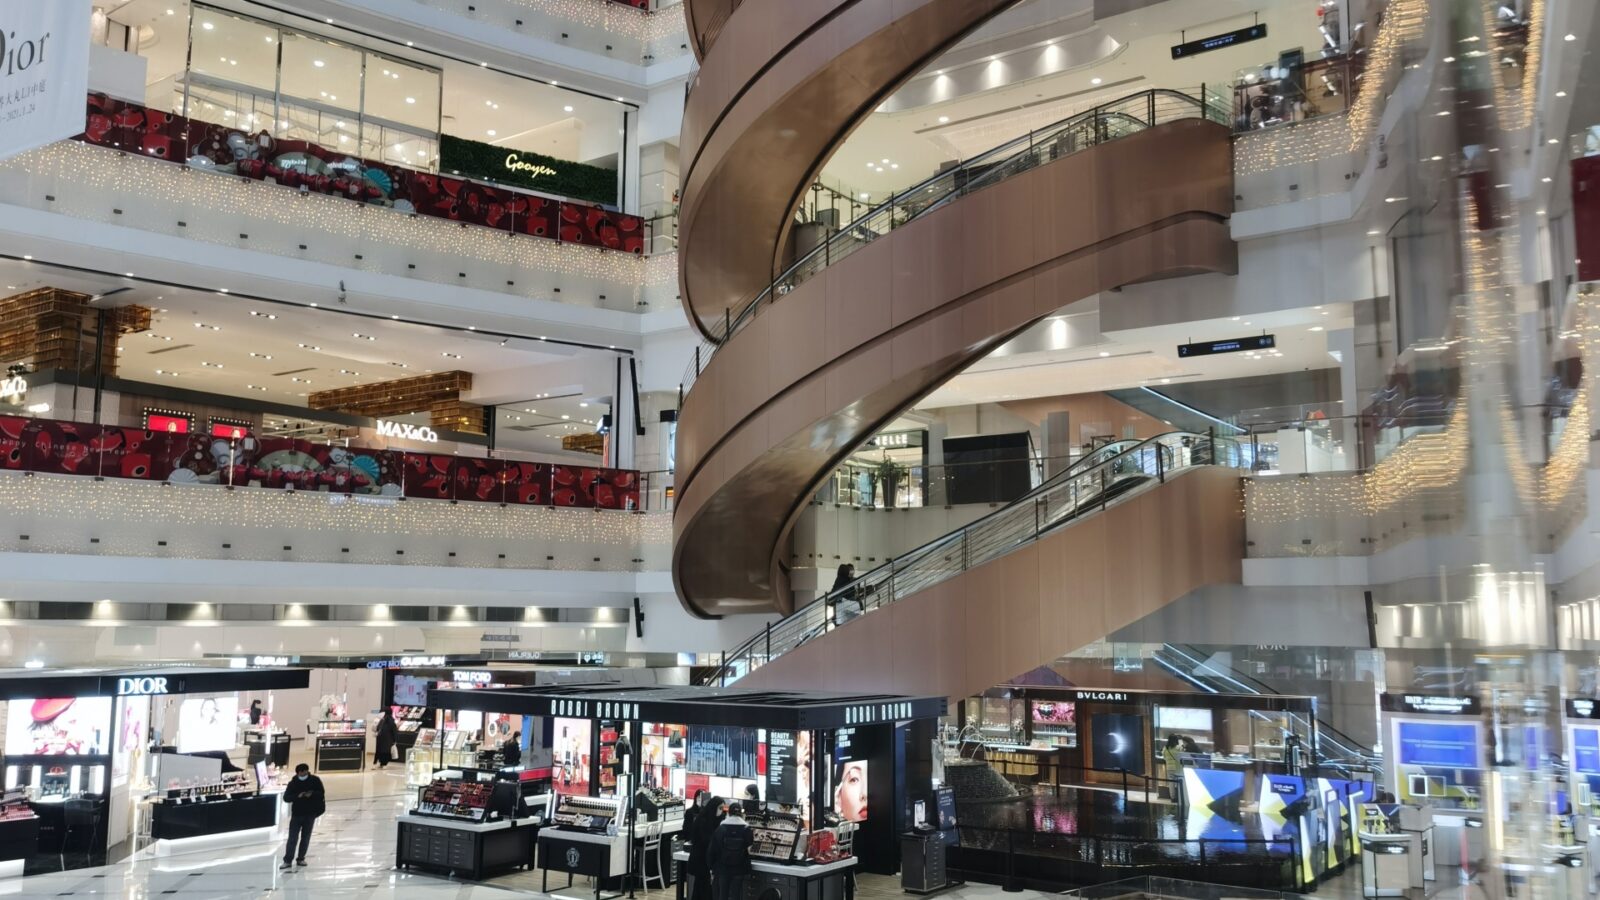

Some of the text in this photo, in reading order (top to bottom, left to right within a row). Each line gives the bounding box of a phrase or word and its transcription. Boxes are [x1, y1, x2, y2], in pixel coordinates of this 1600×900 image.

[0, 28, 50, 76] ior
[505, 153, 557, 179] Gooyen
[118, 677, 168, 695] DIOR
[453, 671, 491, 682] TOM FORD
[1077, 691, 1127, 701] BVLGARI
[551, 699, 639, 720] BOBBI BROWN
